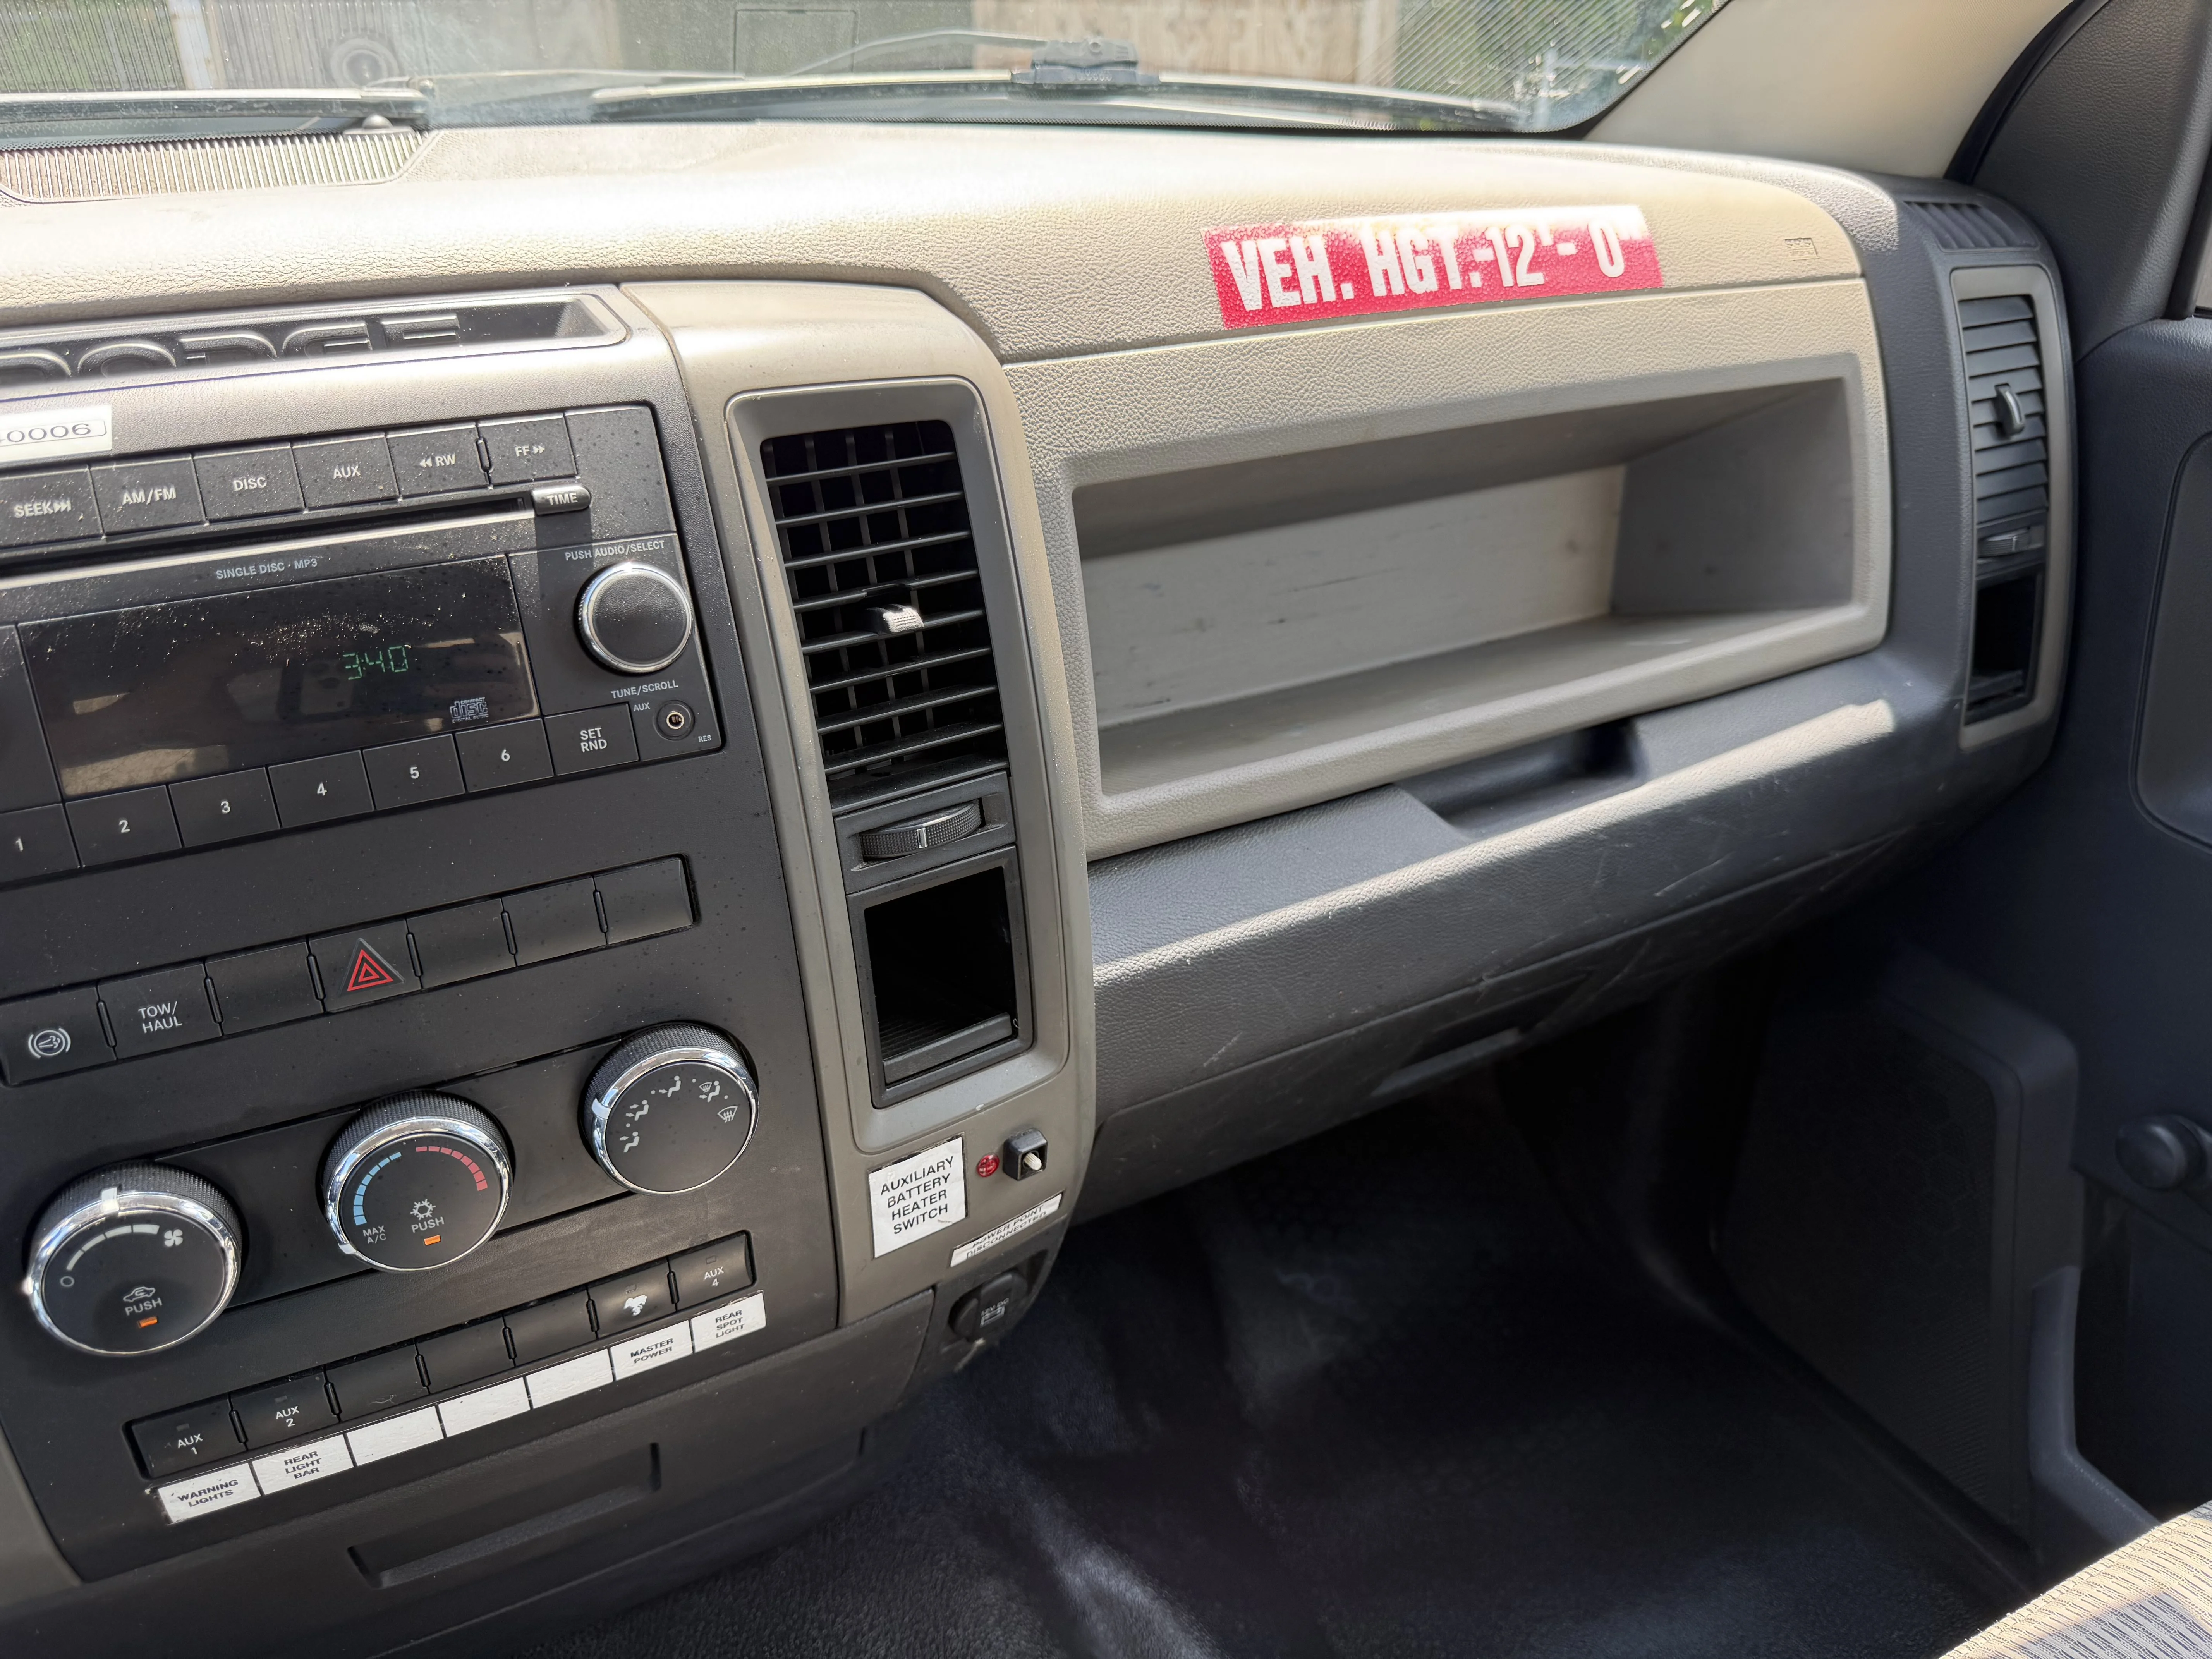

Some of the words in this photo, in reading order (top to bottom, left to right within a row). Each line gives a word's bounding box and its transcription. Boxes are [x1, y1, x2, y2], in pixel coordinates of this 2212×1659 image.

[1221, 235, 1354, 311] VEH.
[0, 423, 91, 442] 0006
[515, 445, 530, 457] FF
[435, 454, 457, 467] RW
[333, 465, 361, 480] AUX
[234, 476, 268, 492] DISC
[122, 487, 177, 506] AM/FM
[546, 492, 579, 506] TIME
[14, 501, 53, 519] SEEK
[565, 550, 592, 561] PUSH
[594, 540, 665, 558] AUDIO/SELECT
[216, 565, 257, 580] SINGLE
[259, 562, 285, 574] DISC
[294, 558, 318, 570] MP3
[611, 680, 679, 699] TUNE/SCROLL
[633, 702, 651, 712] AUX
[580, 727, 602, 740] SET
[698, 734, 712, 742] RES
[580, 739, 607, 752] RND
[501, 749, 510, 761] 6
[410, 766, 419, 780] 5
[316, 783, 327, 796] 4
[220, 801, 231, 814] 3
[118, 819, 131, 833] 2
[16, 838, 24, 851] 1
[138, 1001, 178, 1018] TOW/
[142, 1017, 183, 1034] HAUL
[881, 1156, 953, 1195] AUXILIARY
[888, 1173, 950, 1208] BATTERY
[892, 1189, 947, 1221] HEATER
[411, 1216, 445, 1233] PUSH
[893, 1203, 948, 1234] SWITCH
[972, 1223, 1010, 1248] POWER
[1013, 1204, 1044, 1226] POINT
[362, 1225, 386, 1237] MAX
[368, 1233, 386, 1244] A/C
[703, 1266, 724, 1280] AUX
[711, 1278, 719, 1287] 4
[124, 1297, 163, 1316] PUSH
[715, 1310, 742, 1323] REAR
[716, 1317, 743, 1330] SPOT
[716, 1324, 745, 1338] LIGHT
[630, 1338, 673, 1357] MASTER
[634, 1346, 673, 1364] POWER
[275, 1406, 300, 1420] AUX
[286, 1418, 295, 1427] 2
[177, 1433, 203, 1448] AUX
[284, 1451, 318, 1466] REAR
[285, 1458, 322, 1474] LIGHT
[294, 1467, 320, 1479] BAR
[177, 1479, 239, 1502] WARNING
[188, 1489, 234, 1507] LIGHTS
